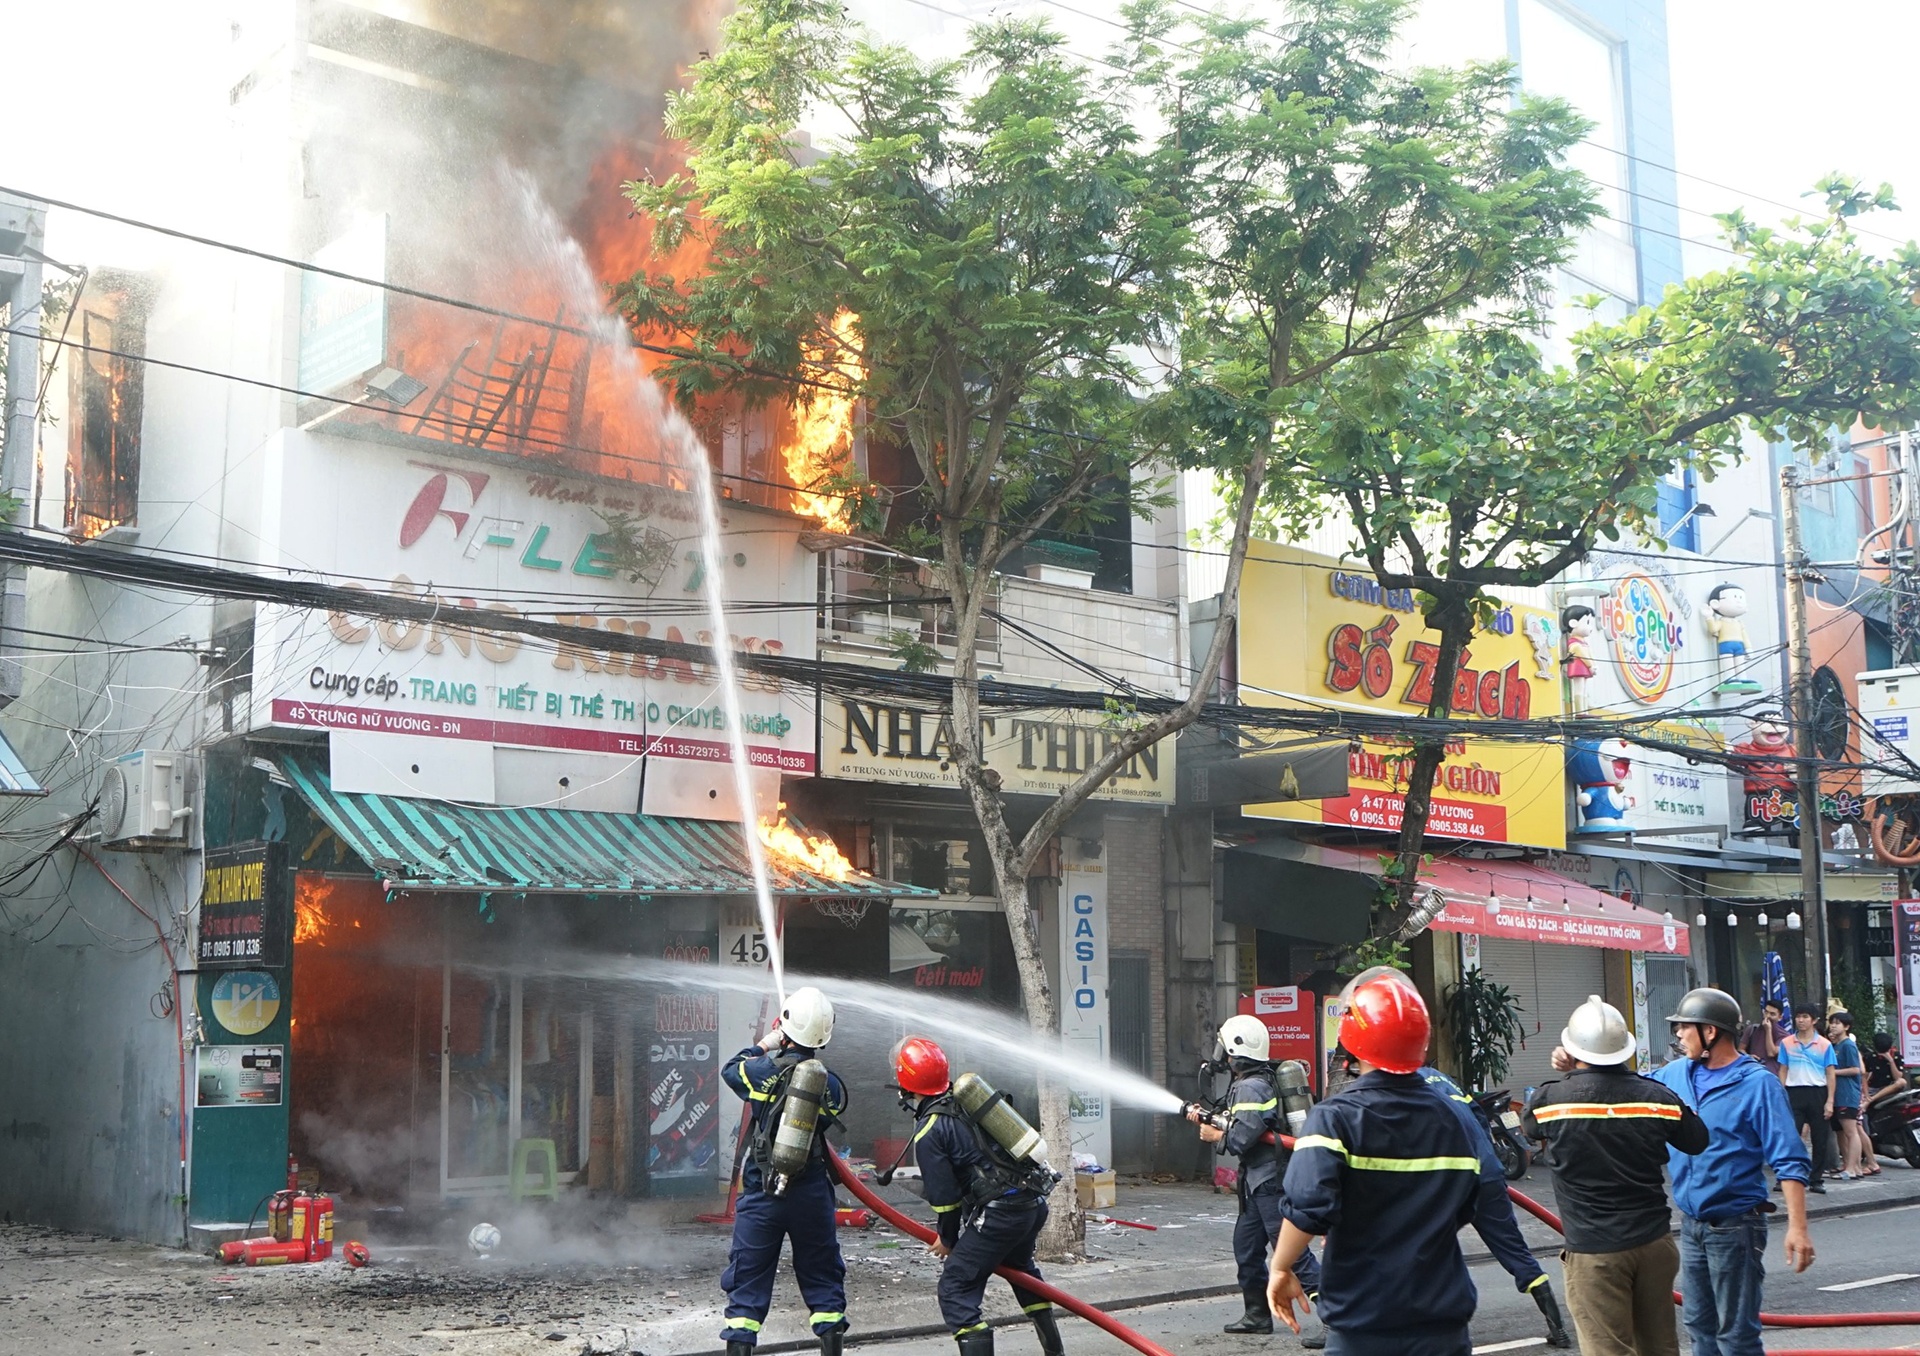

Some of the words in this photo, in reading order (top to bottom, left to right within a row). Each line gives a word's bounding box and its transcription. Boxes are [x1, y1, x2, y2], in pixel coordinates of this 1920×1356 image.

[1601, 587, 1647, 660] Hồng
[1325, 614, 1400, 699] Số
[310, 666, 361, 698] Cung
[410, 677, 477, 705] TRANG
[545, 692, 562, 718] BỊ
[570, 693, 604, 719] THỂ
[612, 700, 660, 724] THO
[290, 707, 306, 719] 45
[310, 707, 358, 725] TRƯNG
[361, 711, 381, 727] NỮ
[384, 716, 431, 732] VƯƠNG
[442, 722, 461, 734] ĐN
[650, 741, 720, 758] 0511.3572975
[750, 750, 806, 769] 0905.10336
[840, 765, 851, 773] 45
[853, 765, 886, 777] TRƯNG
[903, 770, 936, 781] VƯƠNG
[1372, 797, 1384, 808] 47
[1439, 805, 1474, 820] VƯƠNG
[1429, 819, 1468, 834] 0905.358
[1469, 822, 1485, 836] 443
[1496, 913, 1514, 927] CƠM
[1538, 916, 1558, 932] ZÁCH
[213, 940, 231, 957] 0905
[232, 939, 246, 956] 100
[245, 938, 260, 955] 336
[730, 933, 769, 963] 45
[1073, 894, 1096, 1010] CASIO
[650, 1068, 683, 1107] WHITE
[677, 1099, 711, 1138] PEARL
